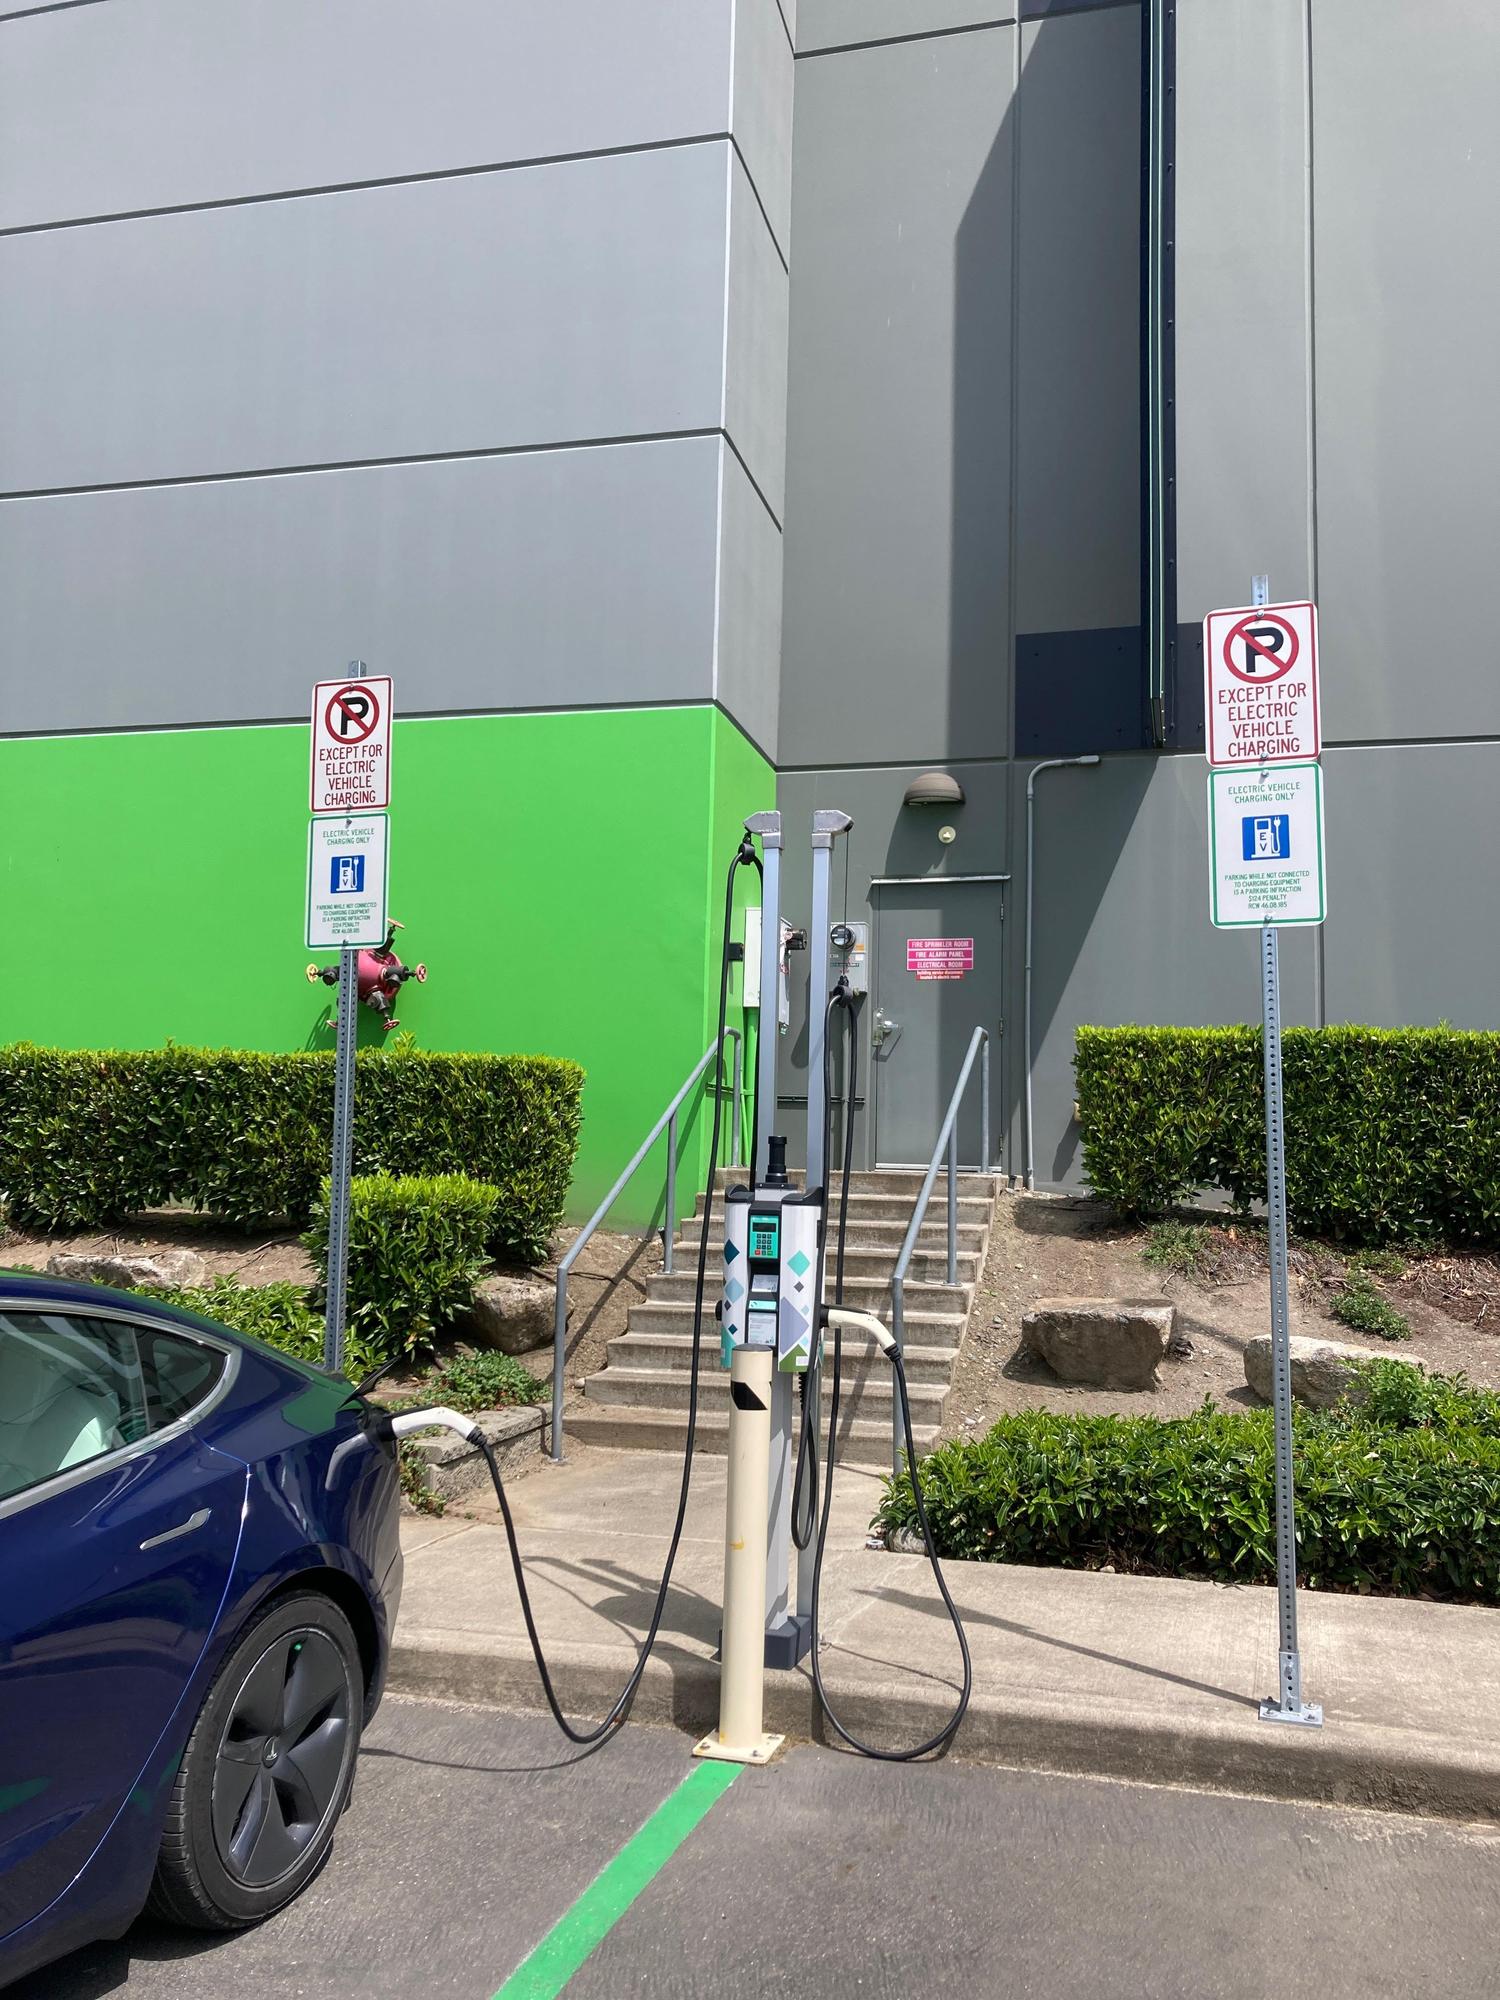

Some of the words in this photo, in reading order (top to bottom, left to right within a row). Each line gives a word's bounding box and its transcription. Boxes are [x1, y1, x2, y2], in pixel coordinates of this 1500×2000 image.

[1218, 685, 1273, 704] EXCEPT
[1278, 682, 1307, 699] FOR
[1228, 701, 1298, 721] ELECTRIC
[1232, 720, 1294, 739] VEHICLE
[319, 746, 359, 761] EXCEPT
[362, 744, 383, 758] FOR
[1228, 737, 1300, 757] CHARGING
[325, 760, 376, 776] ELECTRIC
[328, 775, 372, 790] VEHICLE
[1228, 784, 1266, 795] ELECTRIC
[1268, 781, 1301, 792] VEHICLE
[324, 790, 376, 806] CHARGING
[1234, 793, 1273, 804] CHARGING
[1275, 792, 1295, 801] ONLY
[322, 829, 350, 838] ELECTRIC
[351, 827, 375, 836] VEHICLE
[326, 837, 355, 846] CHARGING
[1224, 873, 1248, 881] PARKING
[1249, 872, 1265, 880] WHILE
[1278, 870, 1310, 878] CONNECTED
[1242, 880, 1269, 888] CHARGING
[1269, 878, 1301, 886] EQUIPMENT
[1245, 887, 1269, 895] PARKING
[917, 961, 947, 969] ELECTRICAL
